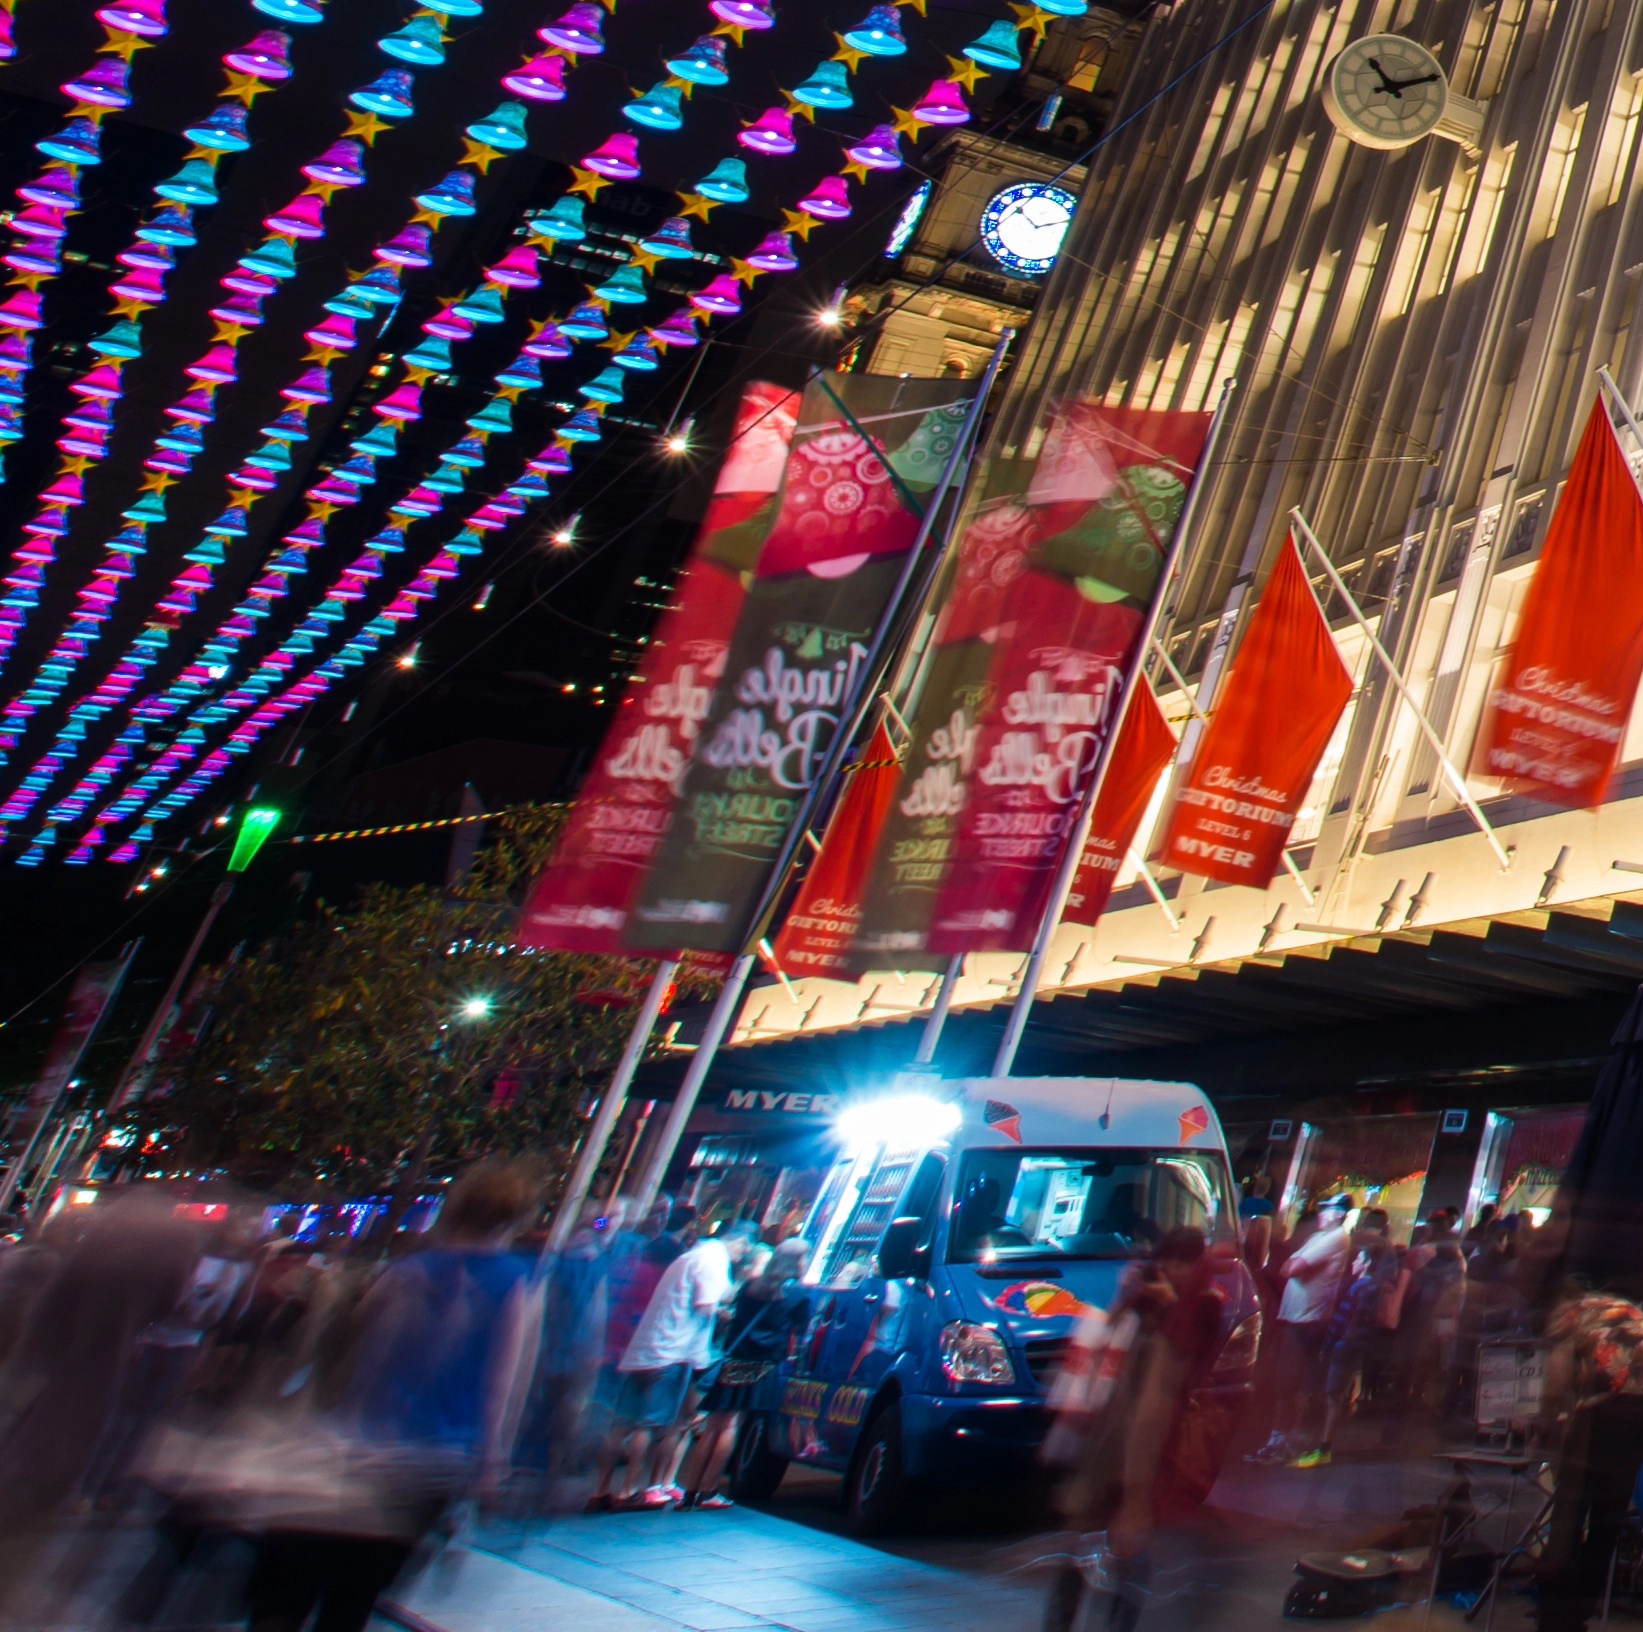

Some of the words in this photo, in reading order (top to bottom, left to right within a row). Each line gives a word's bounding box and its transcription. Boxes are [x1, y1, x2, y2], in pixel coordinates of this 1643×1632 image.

[1515, 664, 1621, 715] Christmas
[1489, 748, 1588, 789] MYER
[1202, 765, 1288, 803] Christmas
[1174, 786, 1297, 829] GIFTORIUM
[1195, 818, 1241, 840] LEVEL
[1242, 829, 1252, 842] 6
[1173, 835, 1256, 868] MYER
[809, 898, 863, 918] Christ
[787, 914, 860, 935] GIFTORI
[805, 936, 842, 949] LEVEL
[724, 1089, 837, 1114] MYER
